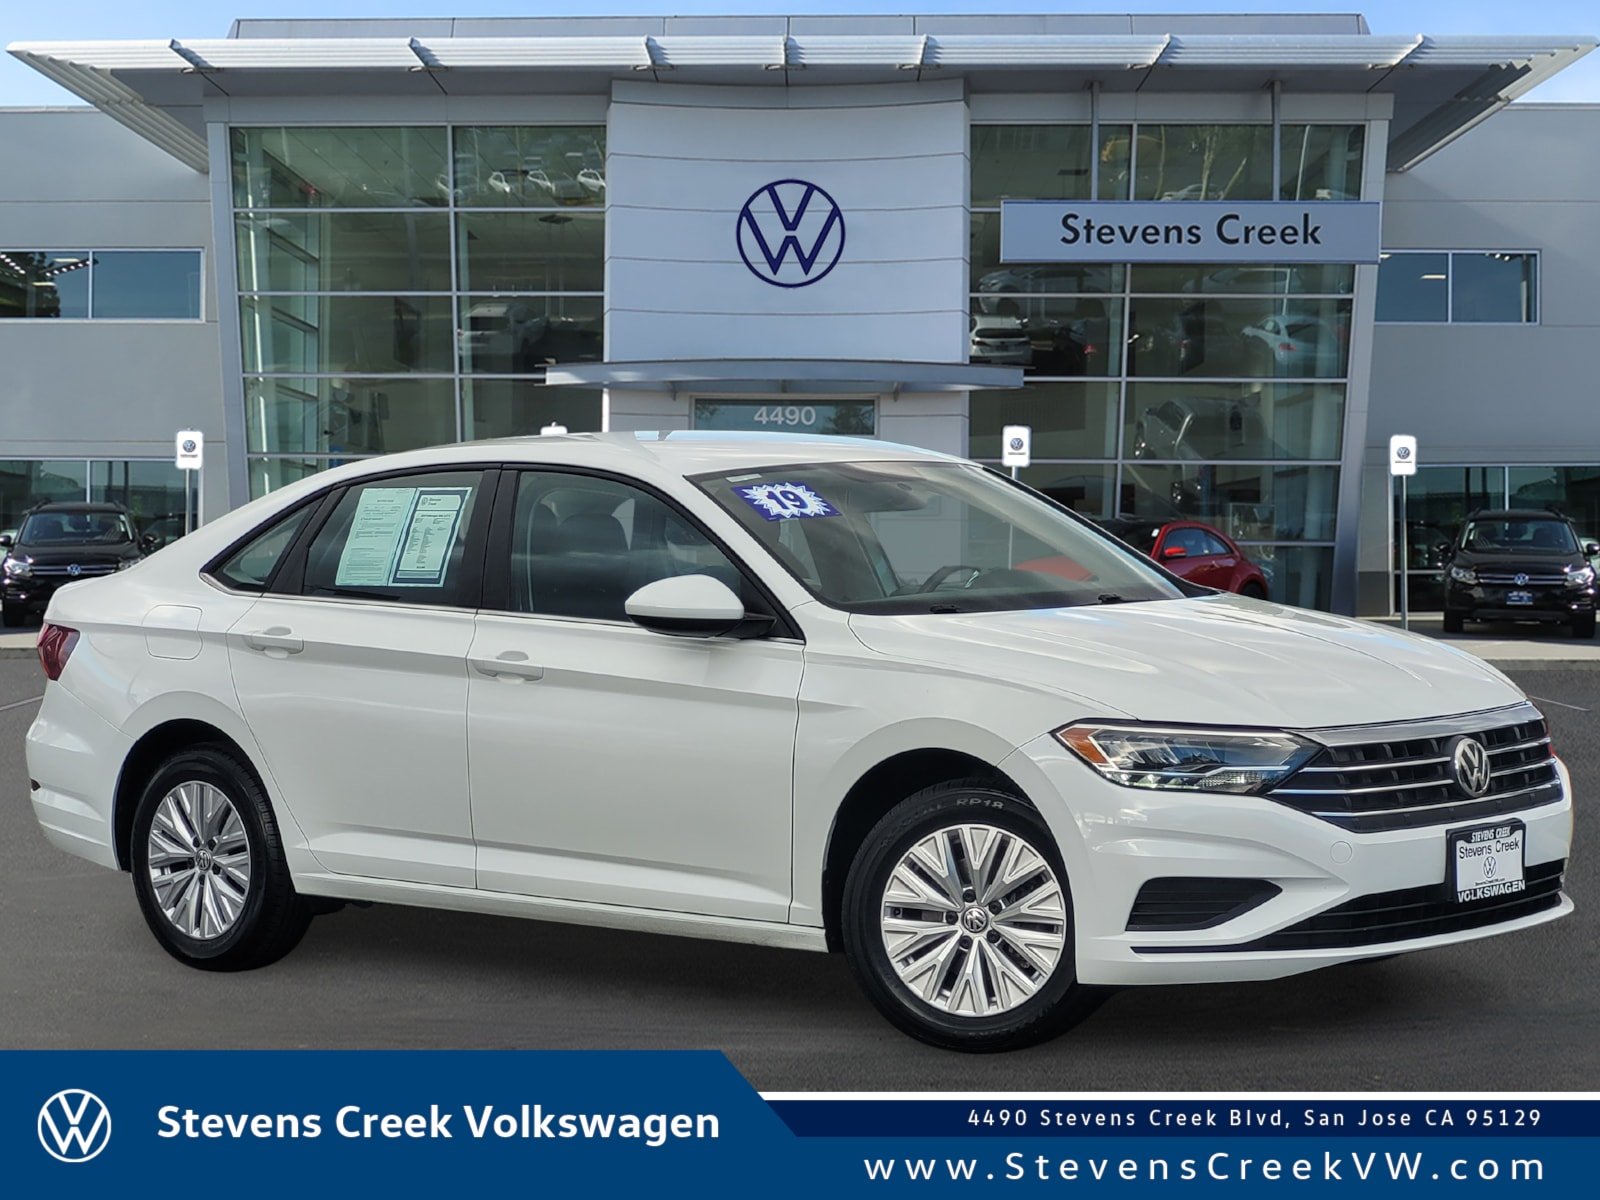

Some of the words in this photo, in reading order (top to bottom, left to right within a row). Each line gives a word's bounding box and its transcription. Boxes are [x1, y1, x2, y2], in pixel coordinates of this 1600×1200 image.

[1060, 213, 1202, 246] Stevens
[1216, 213, 1322, 246] Creek
[753, 406, 816, 426] 4490
[766, 489, 809, 510] 19
[1471, 829, 1495, 843] STEVENS
[1495, 826, 1511, 840] CREEK
[1459, 844, 1493, 860] Stevens
[1495, 837, 1520, 853] Creek
[1457, 880, 1526, 903] VOLKSWAGEN
